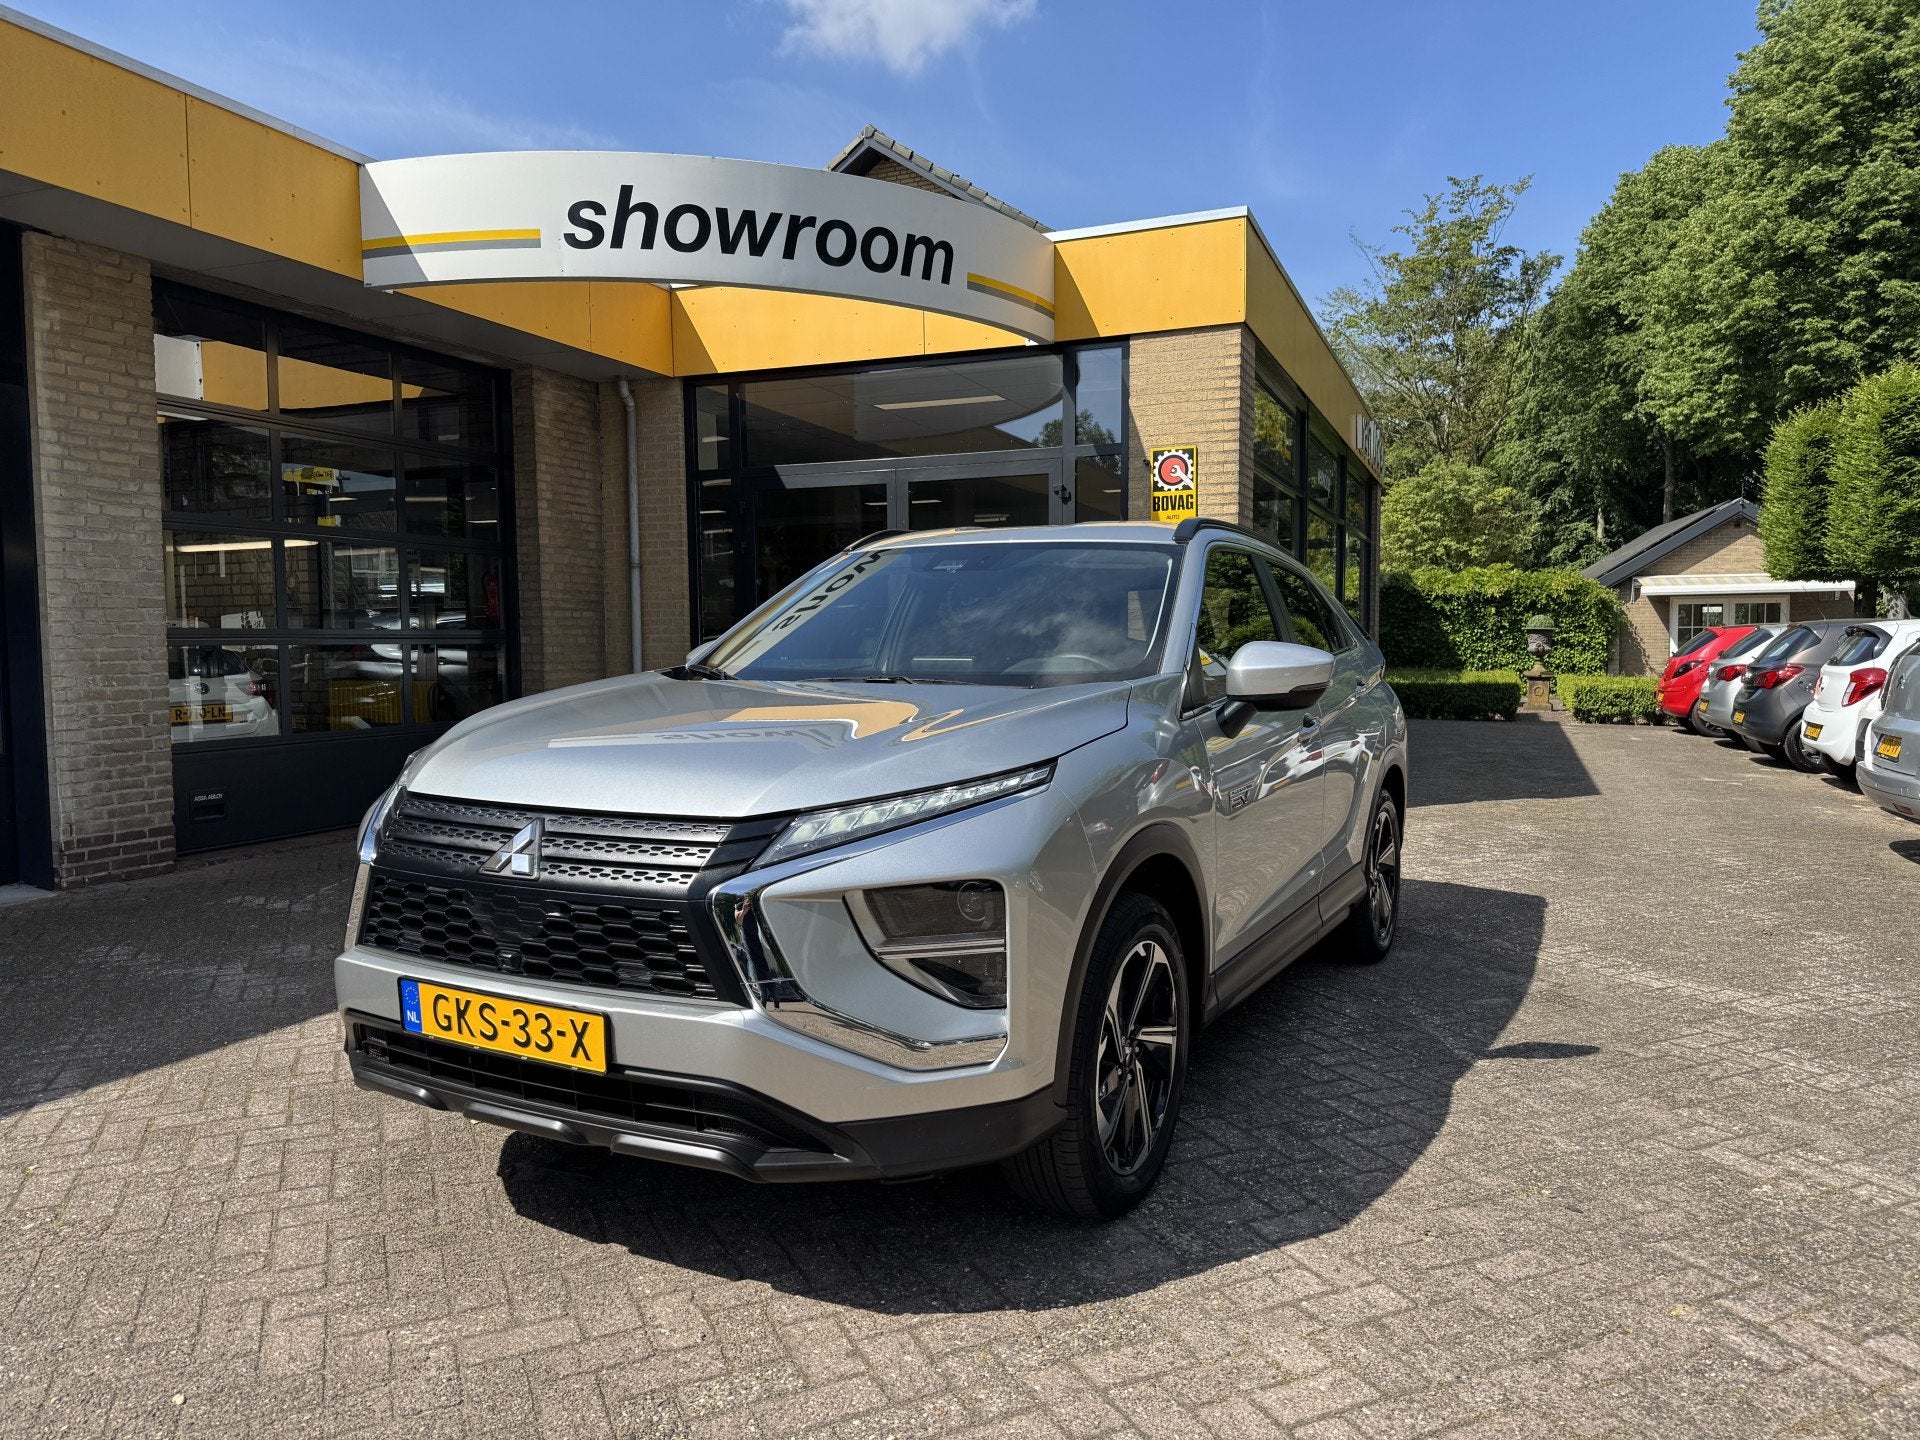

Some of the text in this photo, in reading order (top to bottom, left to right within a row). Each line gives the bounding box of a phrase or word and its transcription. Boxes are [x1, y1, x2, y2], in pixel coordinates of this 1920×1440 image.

[563, 184, 954, 285] showroom
[1153, 494, 1194, 512] BOVAG
[407, 1010, 421, 1024] NL
[432, 993, 593, 1062] GKS-33-X
